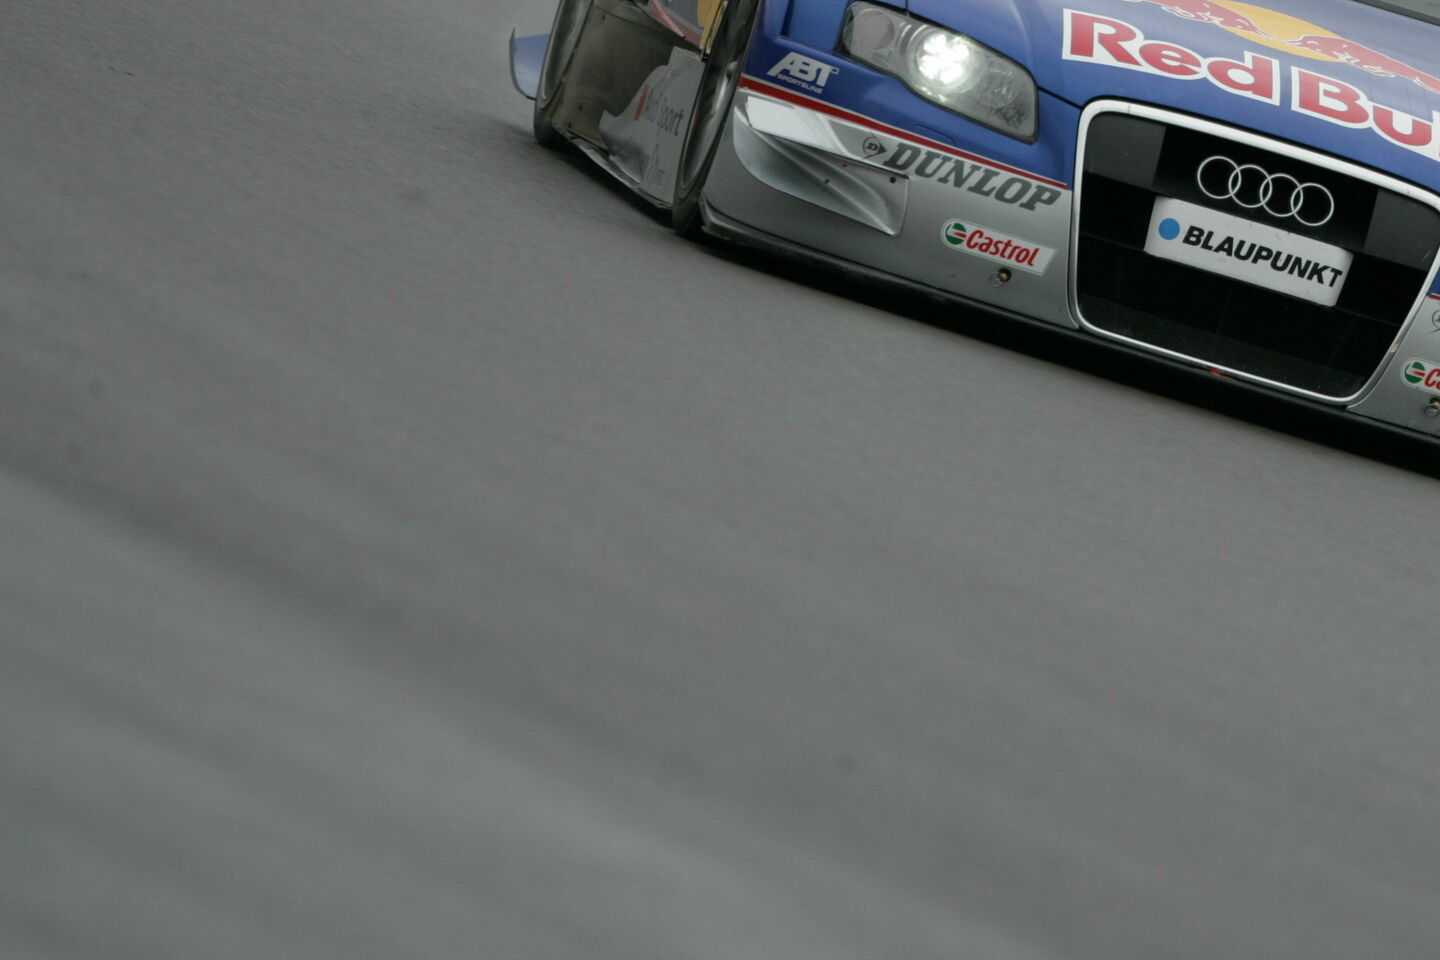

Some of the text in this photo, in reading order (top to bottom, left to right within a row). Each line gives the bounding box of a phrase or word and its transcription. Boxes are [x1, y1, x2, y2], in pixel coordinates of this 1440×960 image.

[767, 51, 833, 88] ABT
[1062, 8, 1280, 106] Red
[882, 142, 1062, 212] DUNLOP
[964, 228, 1040, 267] Castrol
[1181, 225, 1343, 289] BLAUPUNKT
